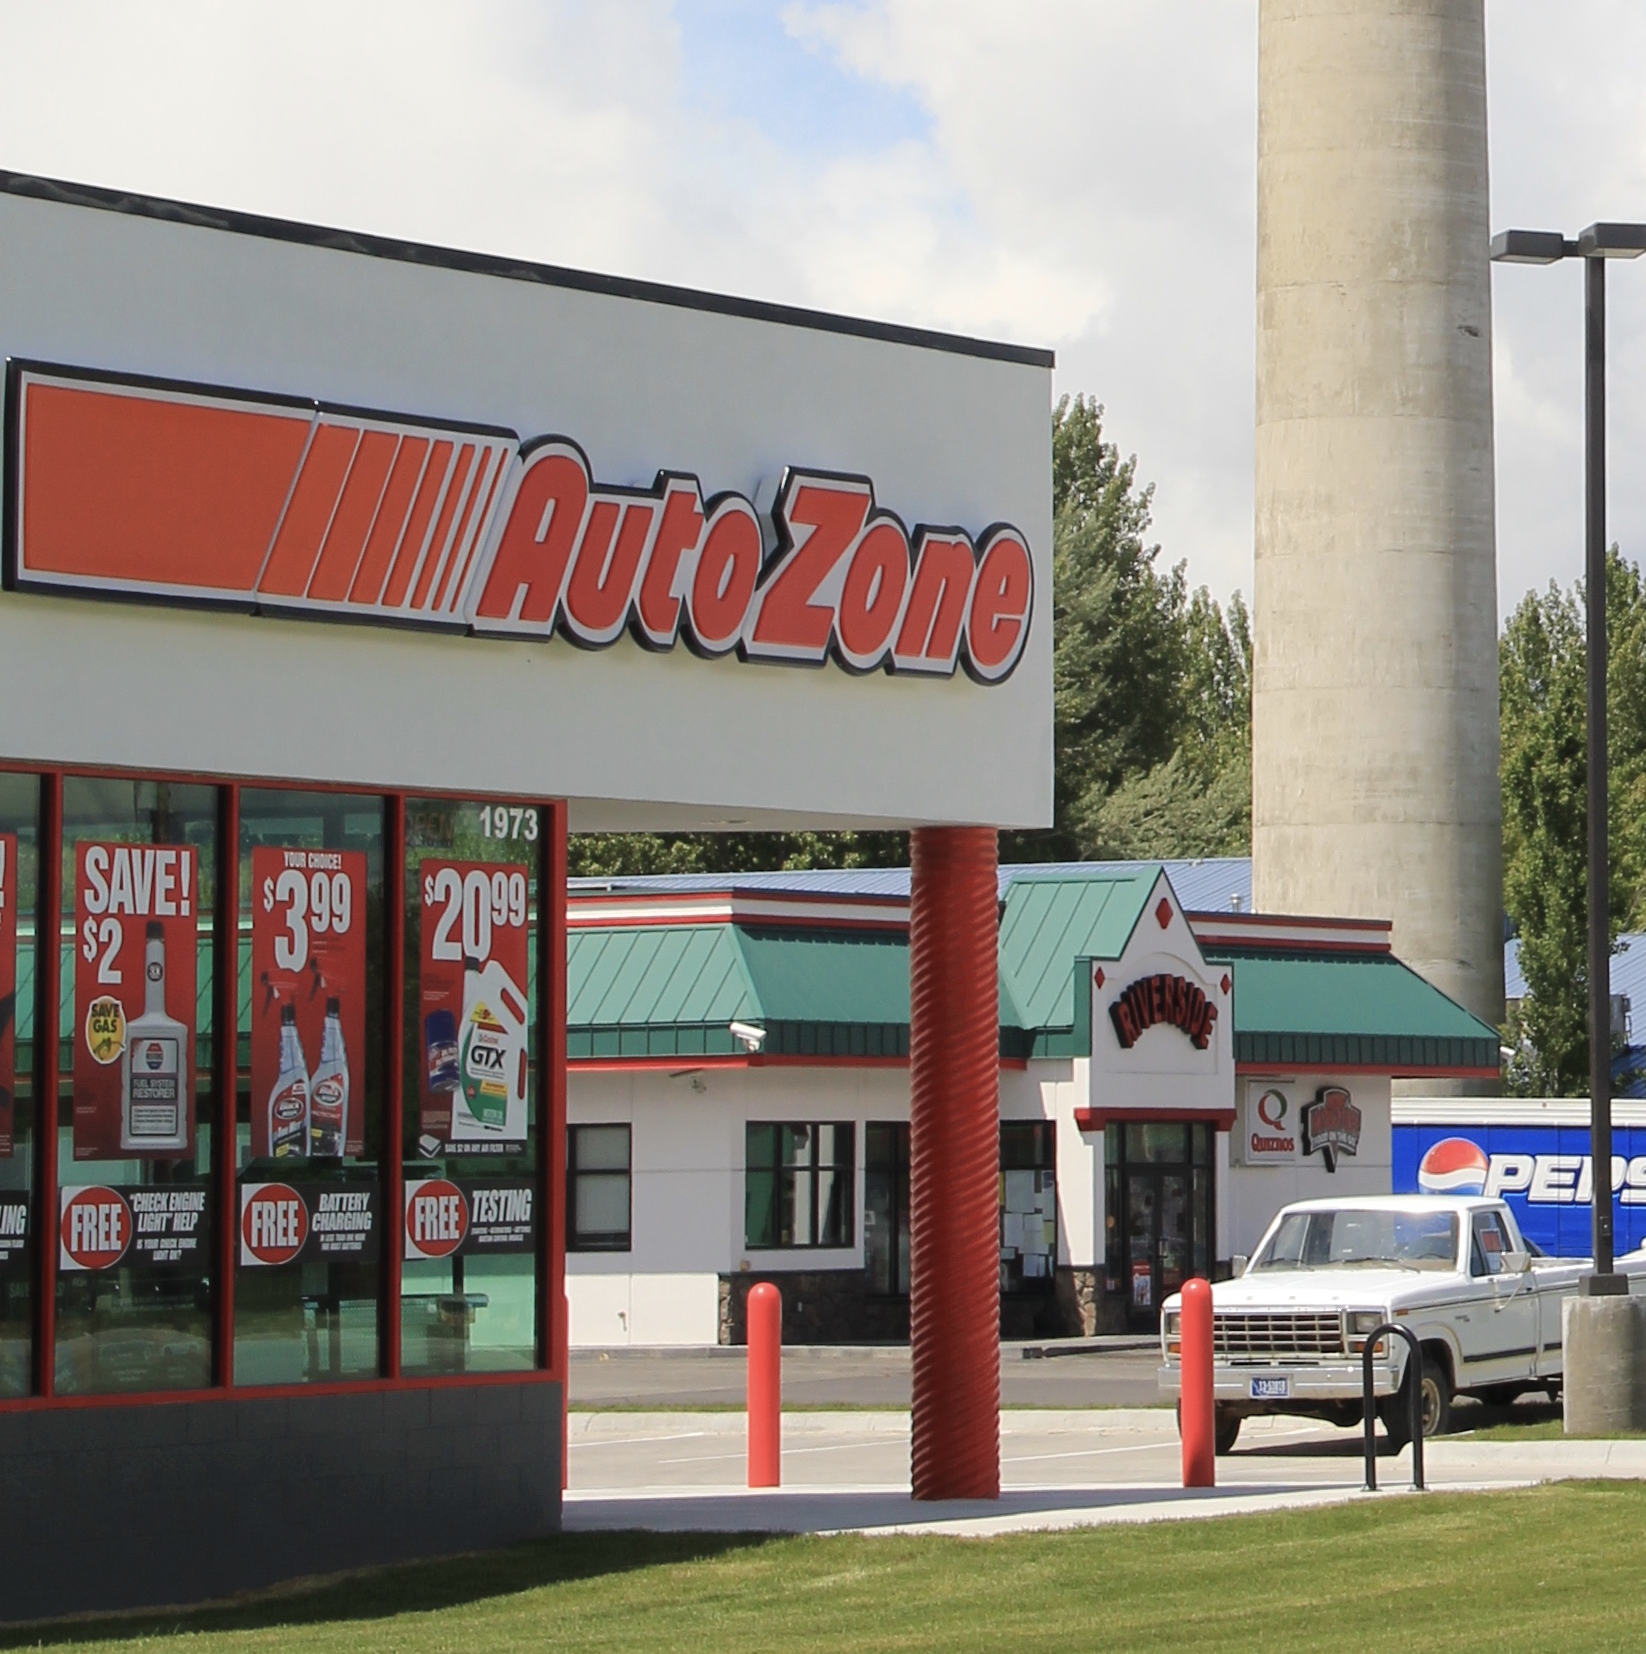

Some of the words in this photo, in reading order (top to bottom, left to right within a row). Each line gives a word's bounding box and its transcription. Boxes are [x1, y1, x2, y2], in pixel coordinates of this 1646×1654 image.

[476, 454, 1030, 669] AutoZone
[479, 805, 539, 841] 1973
[84, 845, 191, 916] SAVE!
[83, 916, 123, 984] $2
[91, 1003, 120, 1018] SAVE
[93, 1019, 117, 1033] GAS
[1109, 974, 1218, 1049] RIVERSIDE
[471, 1045, 507, 1069] GTX
[169, 1192, 206, 1211] ENGINE
[319, 1192, 370, 1212] BATTERY
[415, 1195, 459, 1241] FREE
[472, 1188, 533, 1223] TESTING
[71, 1203, 122, 1253] FREE
[173, 1212, 199, 1232] HELP
[251, 1200, 299, 1247] FREE
[312, 1211, 372, 1232] CHARGING
